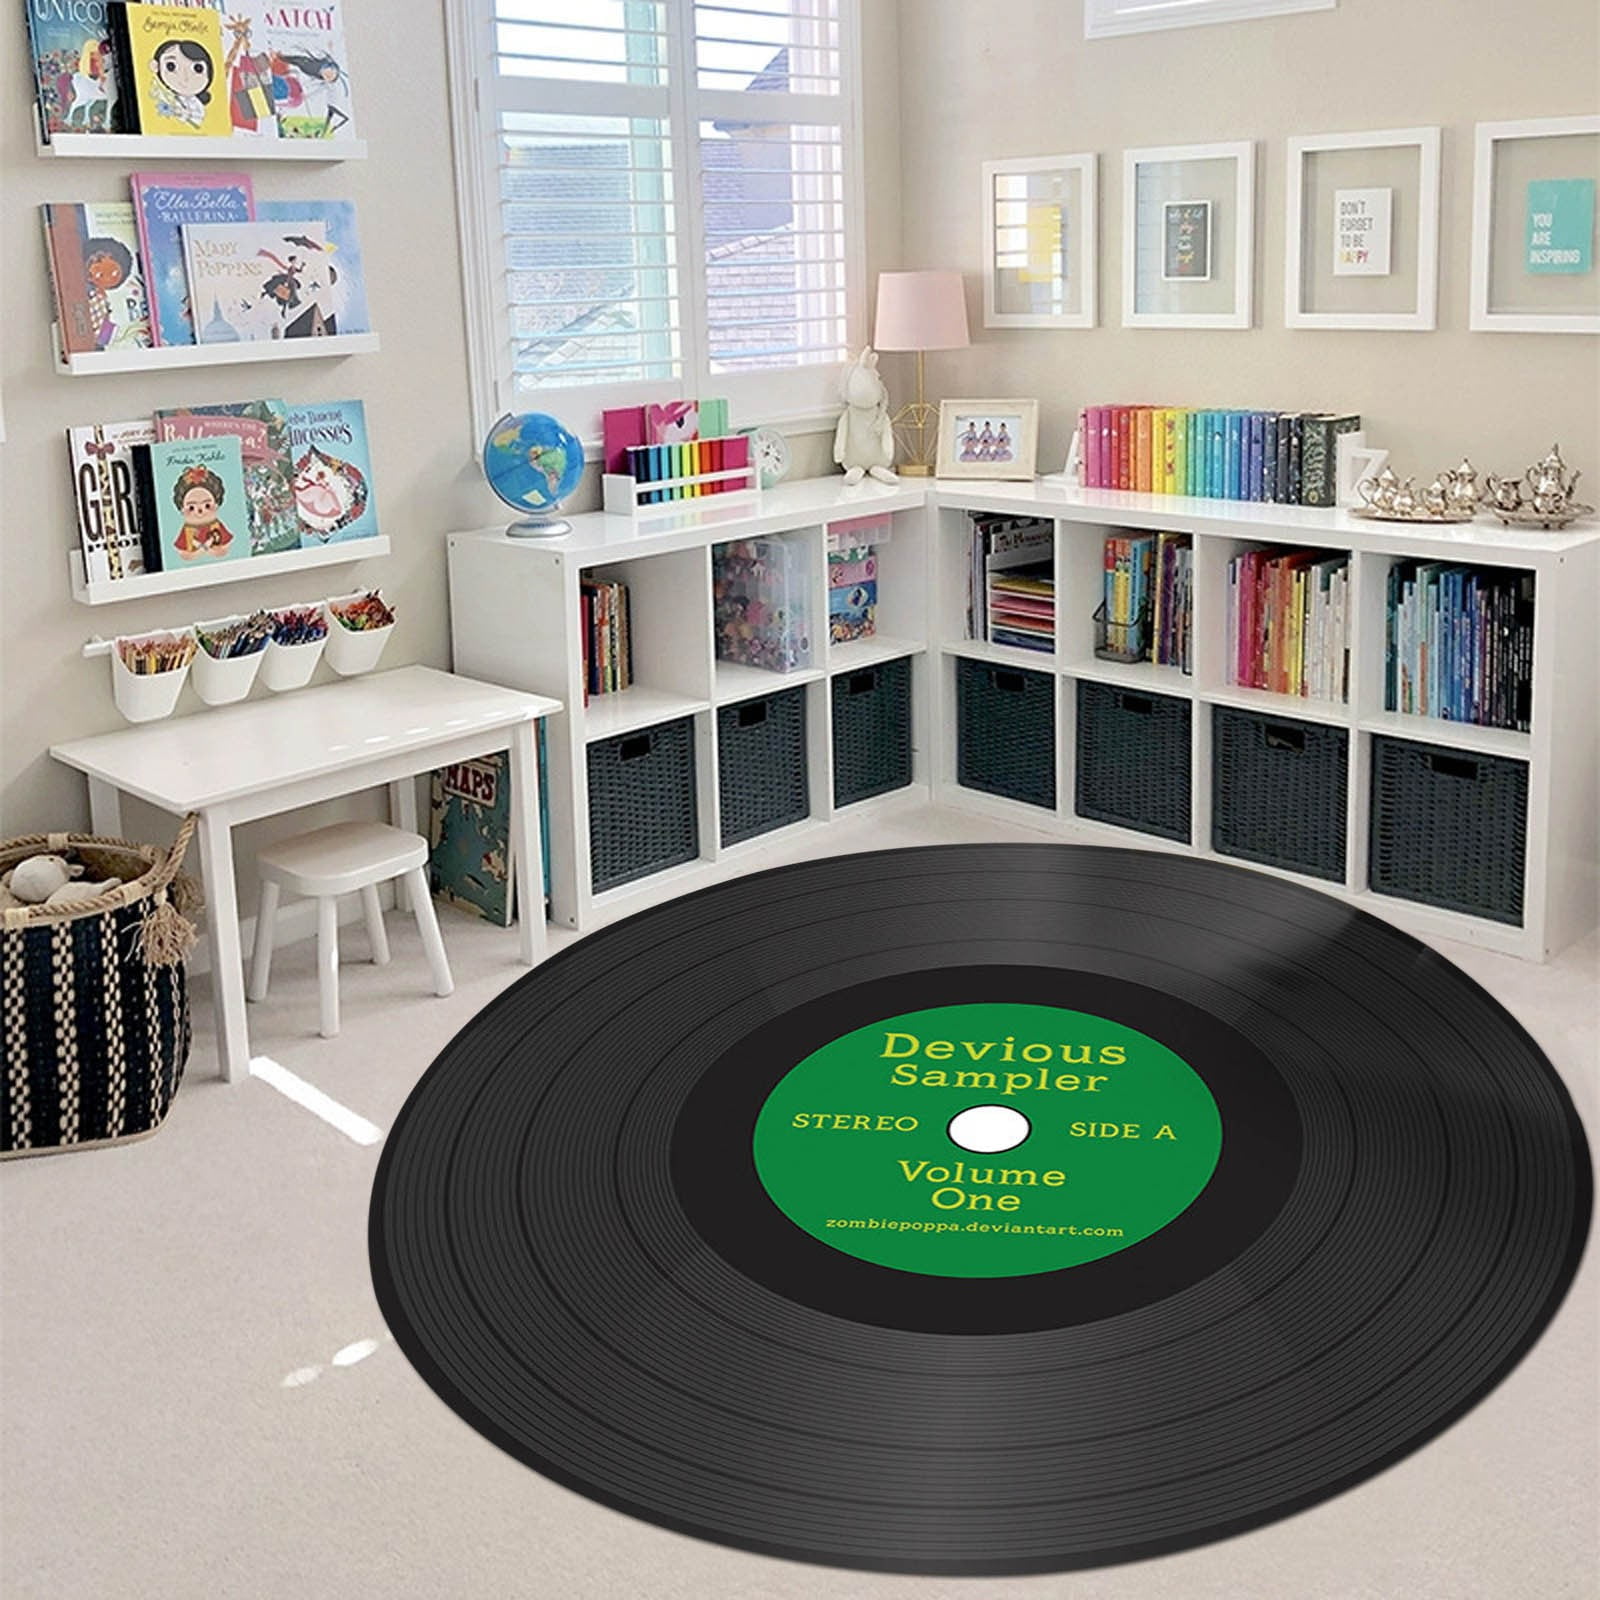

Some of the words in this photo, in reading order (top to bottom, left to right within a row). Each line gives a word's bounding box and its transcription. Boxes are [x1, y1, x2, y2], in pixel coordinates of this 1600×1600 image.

[153, 191, 189, 210] Ella
[190, 191, 240, 210] Bella
[1340, 200, 1366, 215] DON'T
[162, 210, 235, 222] BALLERINA
[1340, 217, 1373, 231] FORGET
[1531, 213, 1552, 228] YOU
[1340, 233, 1352, 248] TO
[1531, 231, 1552, 246] ARE
[1529, 248, 1581, 265] INSPIRING
[446, 765, 494, 801] MAPS
[880, 1032, 1127, 1065] Devious
[890, 1064, 1109, 1095] Sampler
[792, 1113, 919, 1132] STEREO
[1070, 1121, 1141, 1139] SIDE
[1153, 1124, 1177, 1140] A
[898, 1160, 1066, 1187] Volume
[931, 1187, 1021, 1212] One
[826, 1218, 1124, 1237] zombiepoppa.deviantart.com
